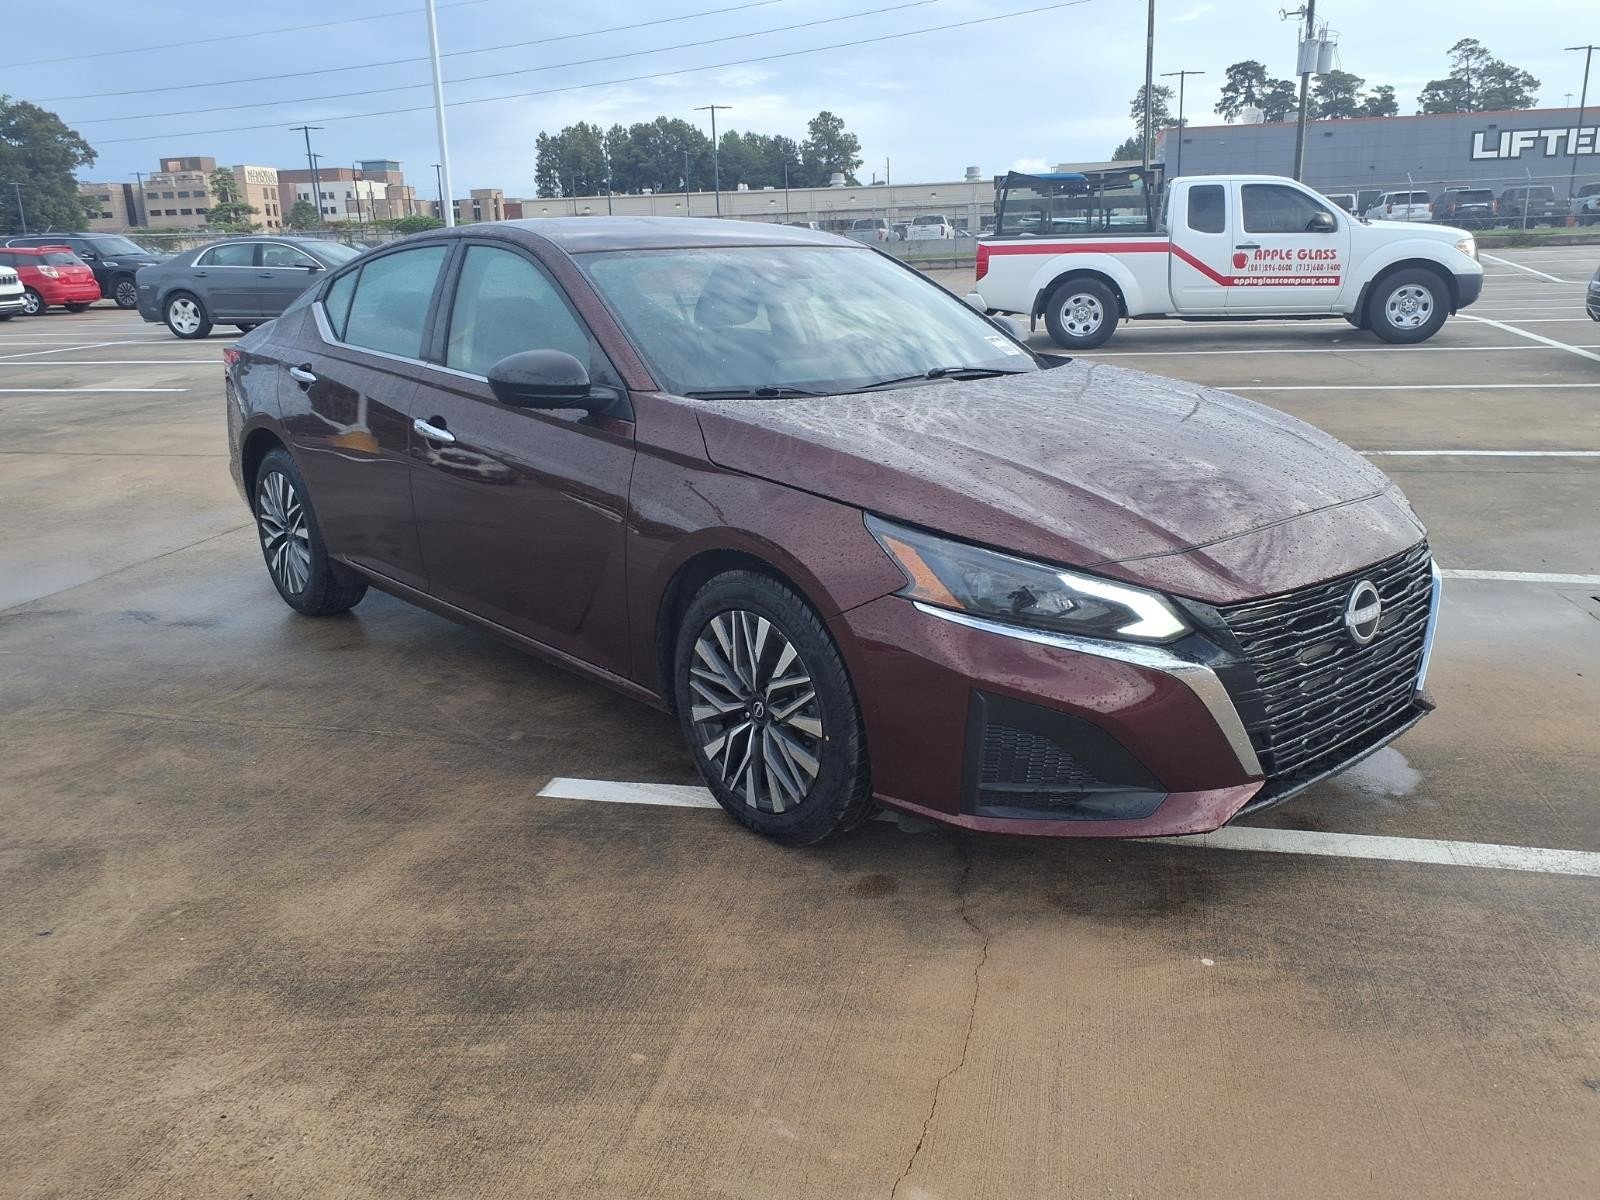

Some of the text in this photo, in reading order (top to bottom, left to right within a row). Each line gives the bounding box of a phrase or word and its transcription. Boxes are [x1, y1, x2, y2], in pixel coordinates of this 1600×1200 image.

[1472, 127, 1600, 159] LIFTE
[1254, 249, 1337, 260] APPLE GLASS
[1233, 277, 1336, 286] appleglasscompany.com
